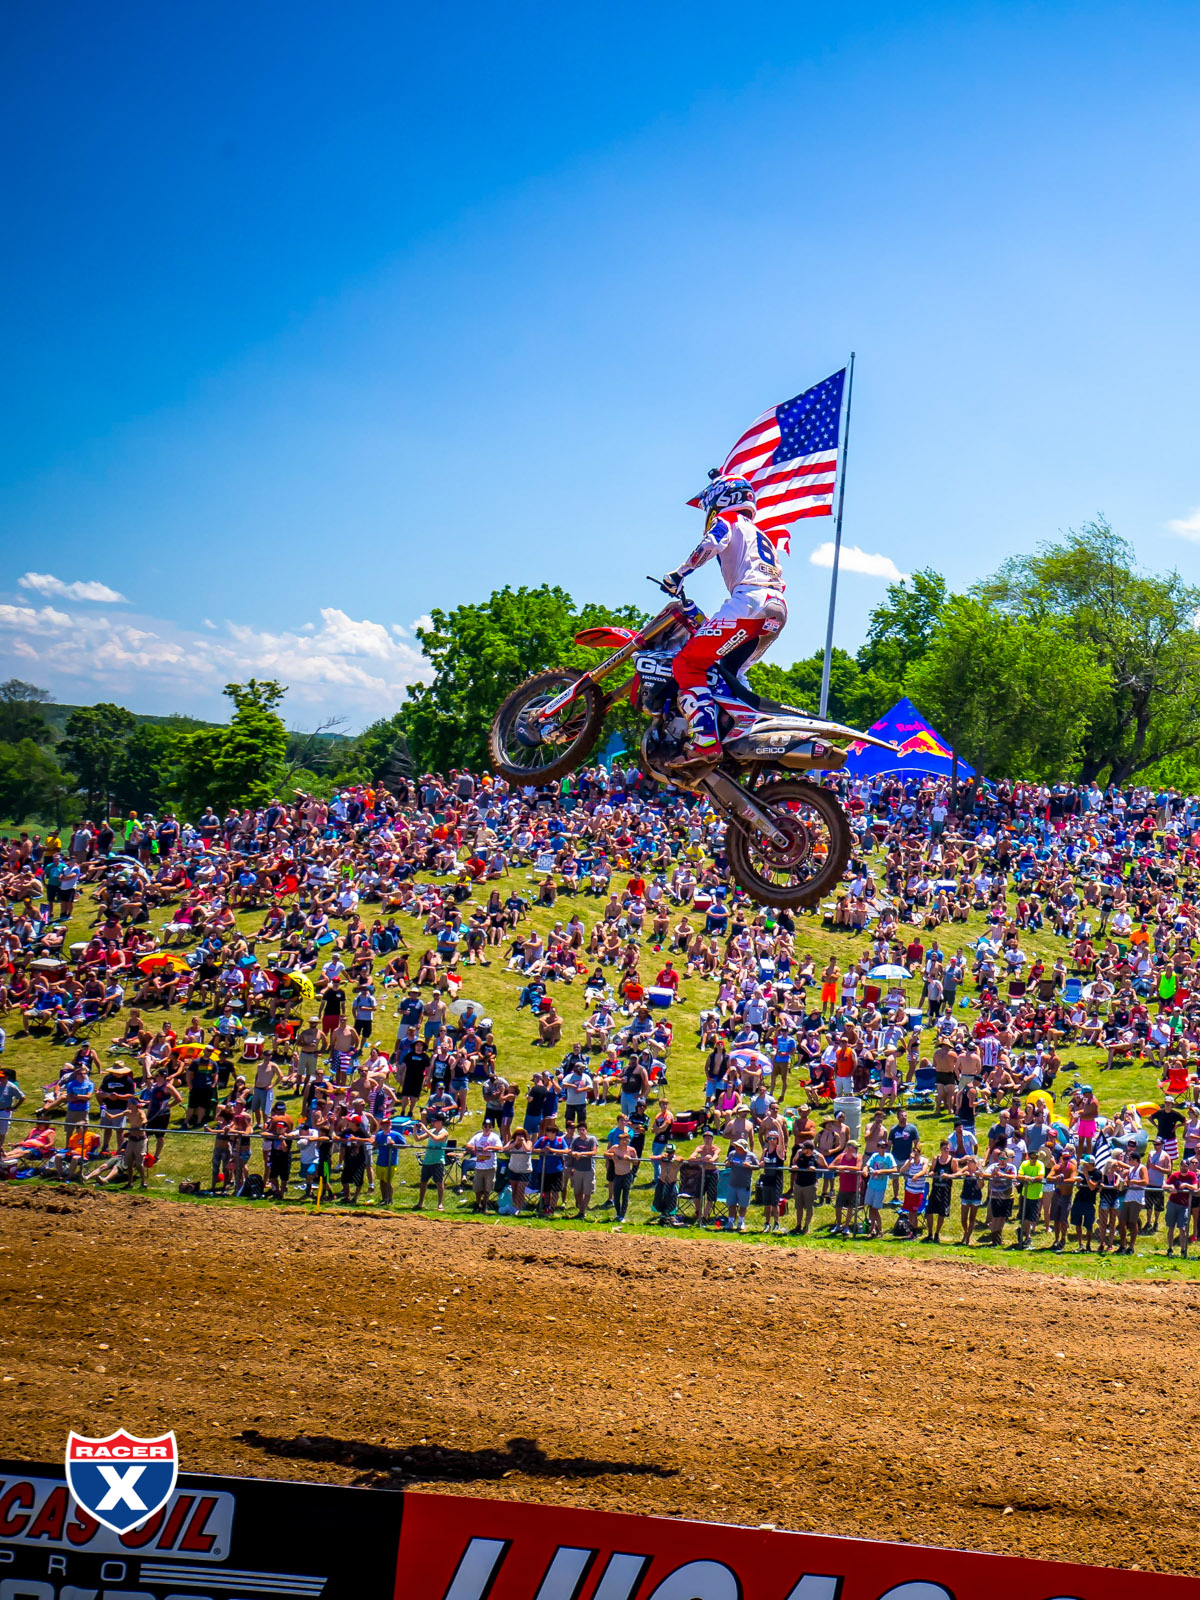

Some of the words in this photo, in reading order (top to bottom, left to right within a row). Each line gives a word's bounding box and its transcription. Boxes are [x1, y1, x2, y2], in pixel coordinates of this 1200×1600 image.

[756, 531, 775, 567] 6
[716, 628, 747, 656] GEICO
[641, 674, 667, 683] HONDA
[780, 703, 808, 716] HONDA
[755, 747, 786, 755] GEICO
[0, 1481, 101, 1546] CAS
